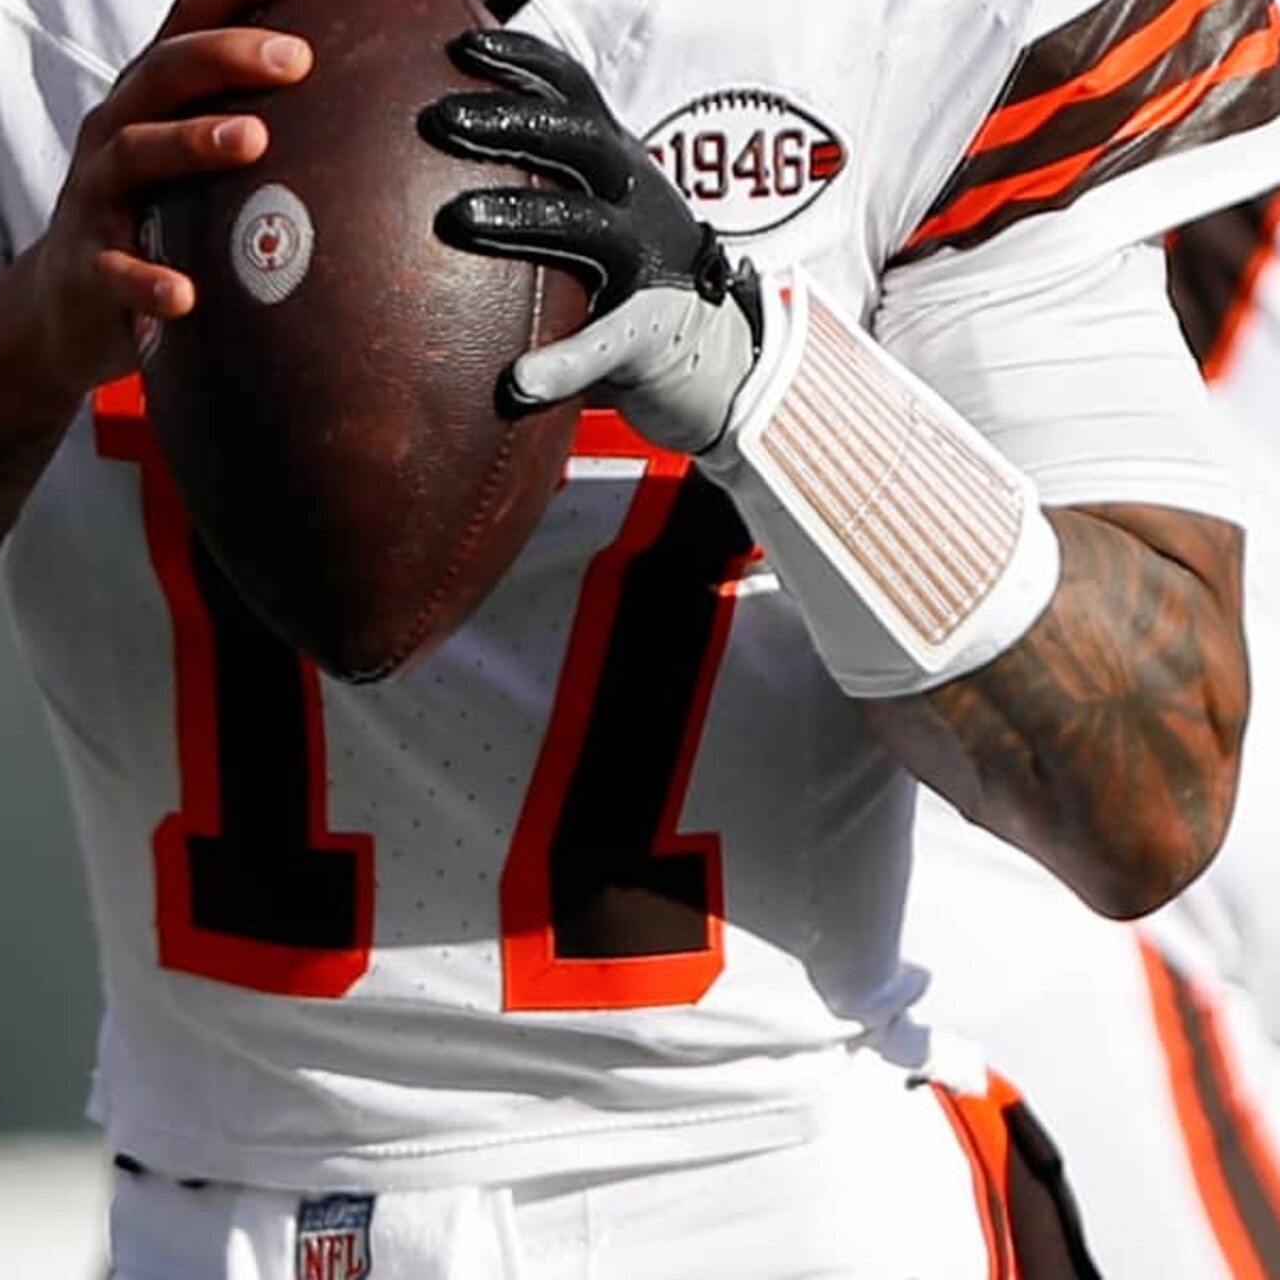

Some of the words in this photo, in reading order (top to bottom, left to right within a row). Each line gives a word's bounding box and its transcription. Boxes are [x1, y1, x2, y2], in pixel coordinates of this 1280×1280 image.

[669, 128, 805, 201] 1946
[92, 370, 763, 1013] 17
[303, 1232, 363, 1280] NFL
